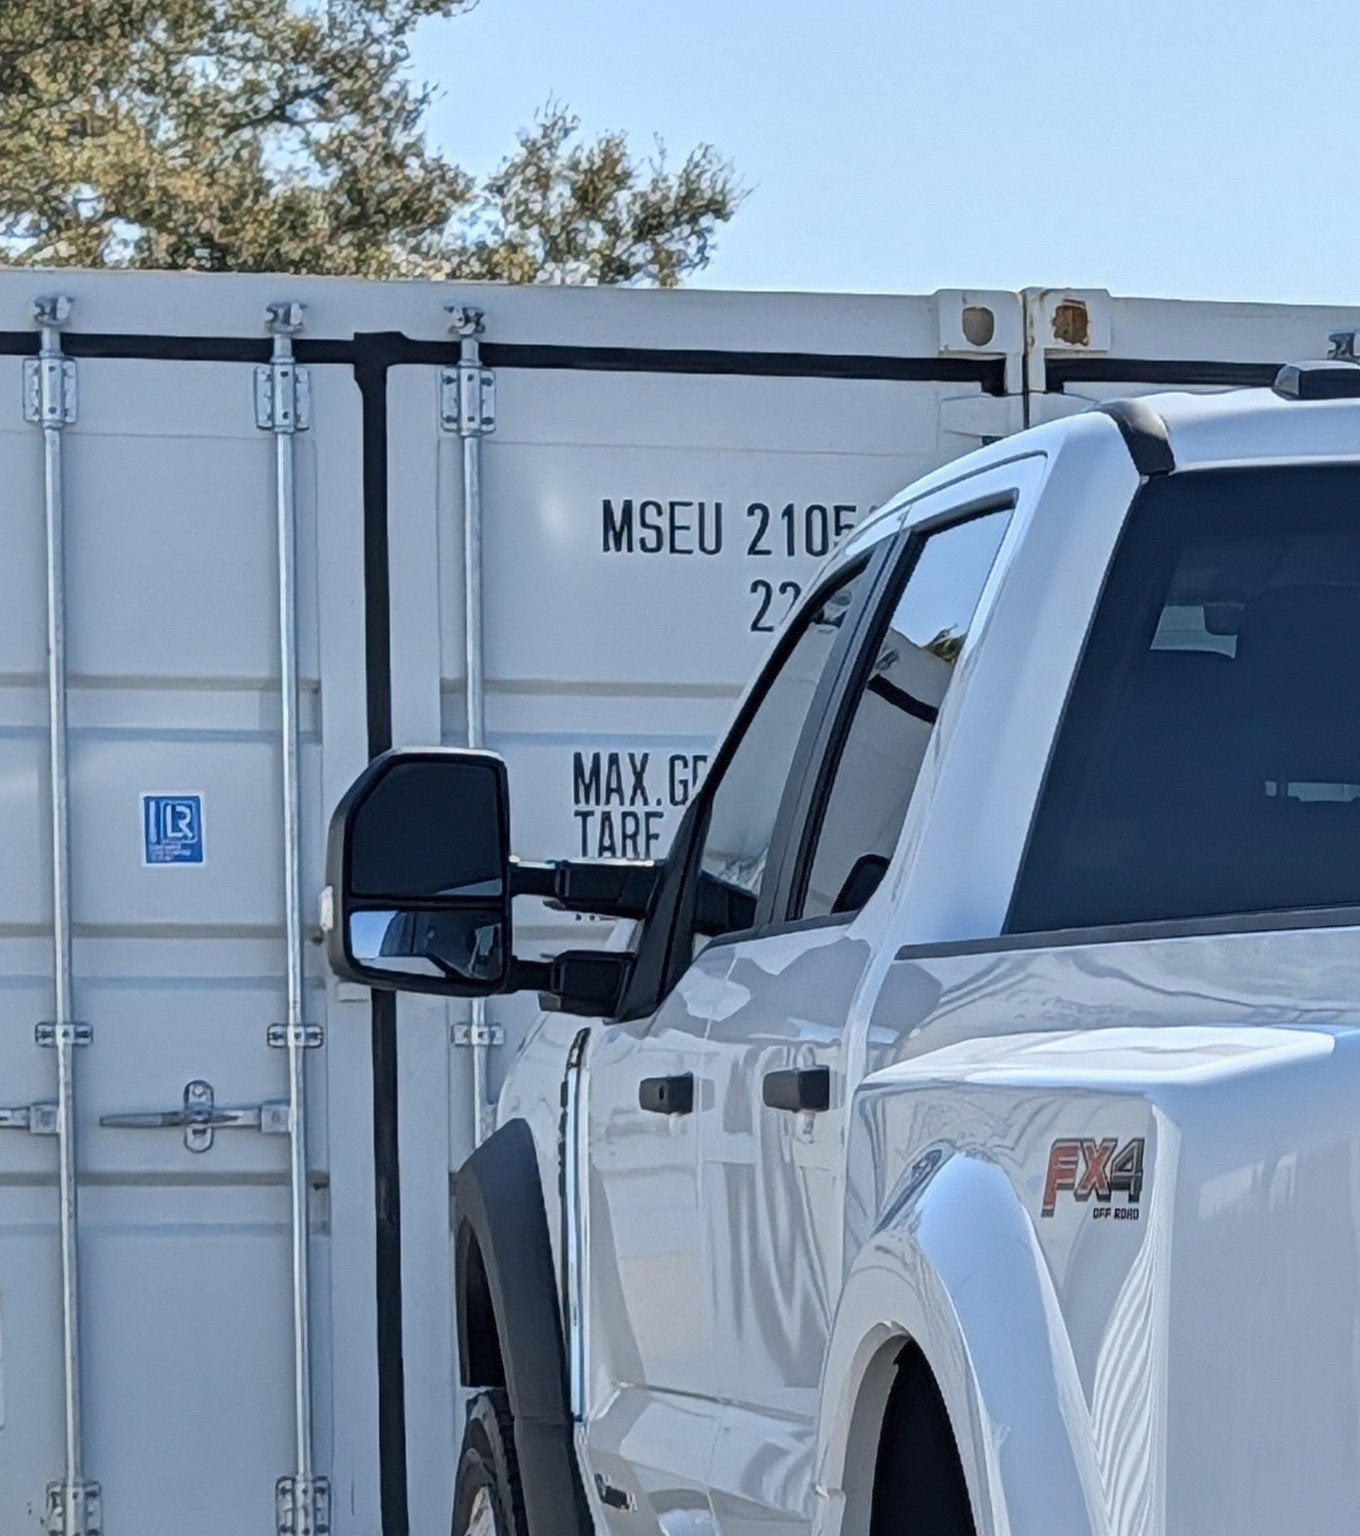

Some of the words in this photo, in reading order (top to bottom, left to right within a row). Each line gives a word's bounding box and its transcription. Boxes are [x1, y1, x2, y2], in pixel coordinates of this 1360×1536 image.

[602, 499, 723, 555] MSEU
[1041, 1137, 1145, 1218] FX4
[1093, 1207, 1112, 1220] OFF
[1114, 1207, 1140, 1220] ROAD
